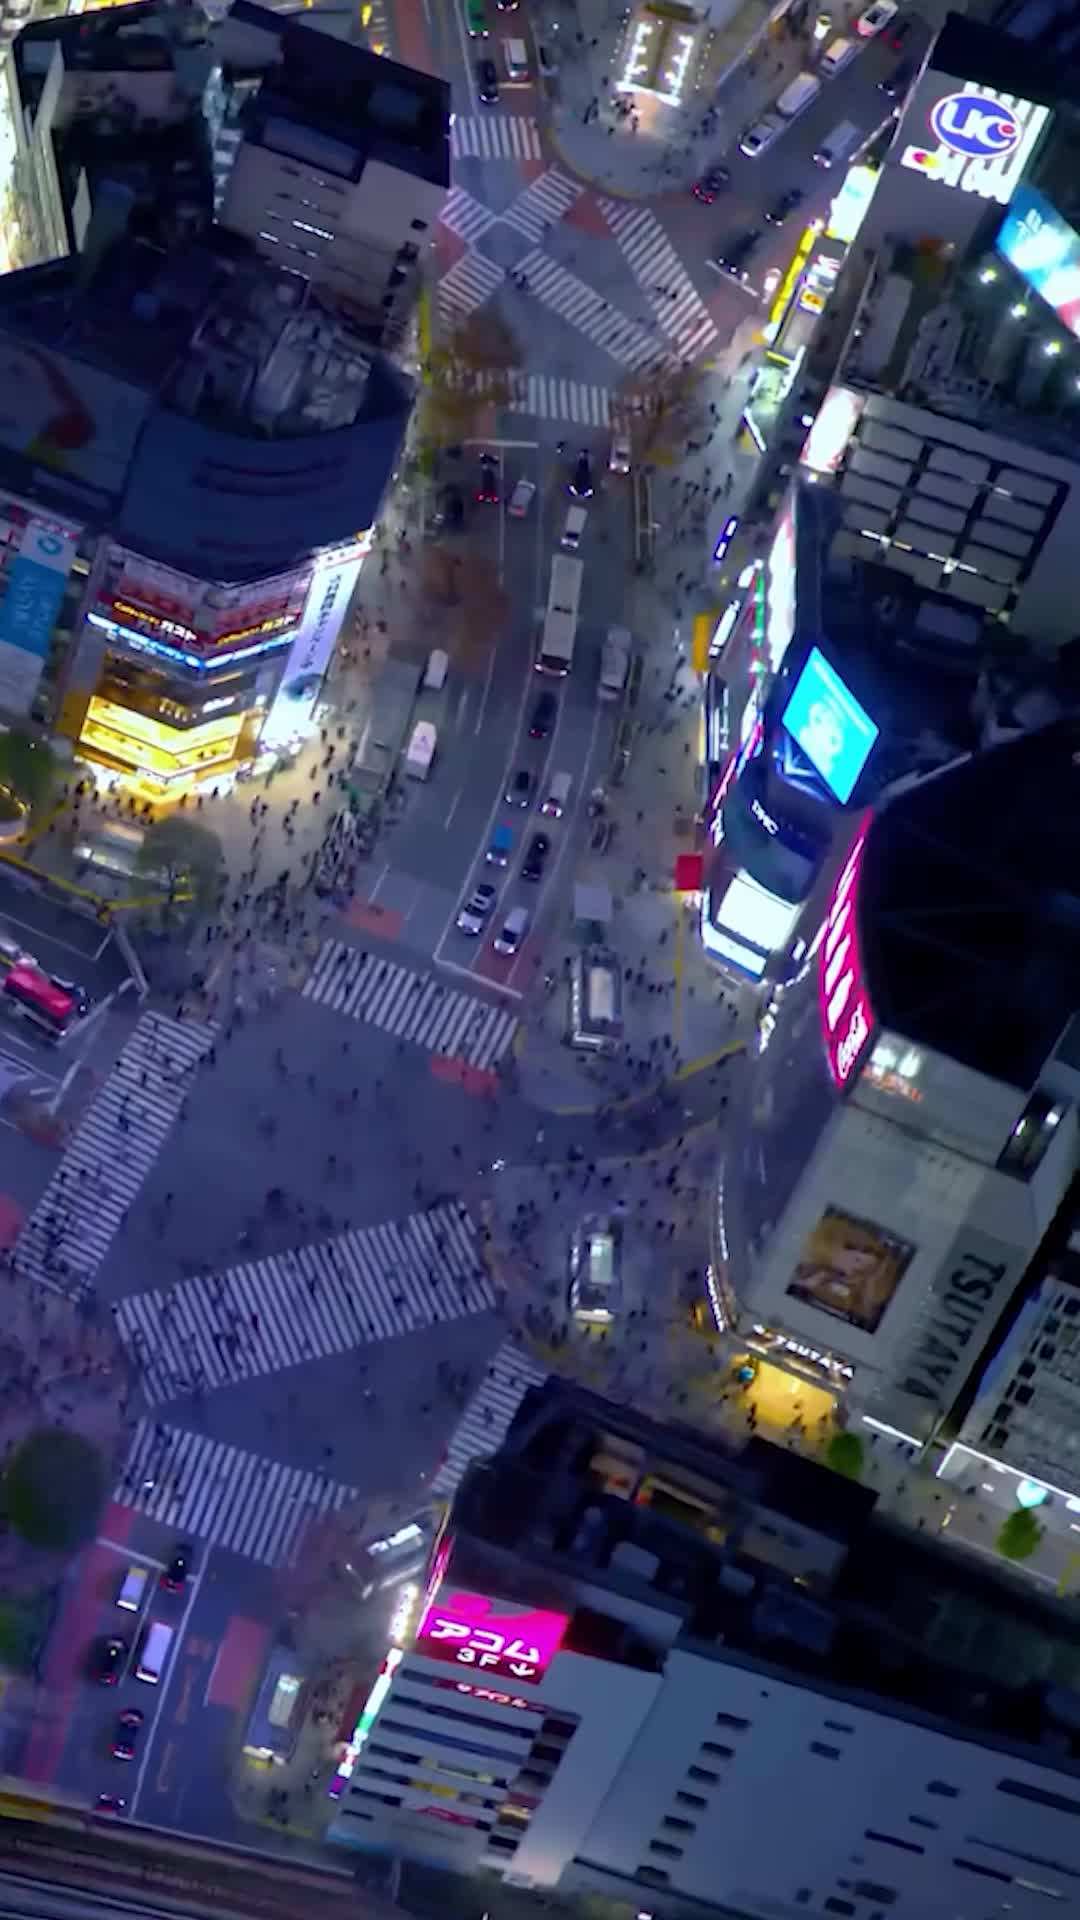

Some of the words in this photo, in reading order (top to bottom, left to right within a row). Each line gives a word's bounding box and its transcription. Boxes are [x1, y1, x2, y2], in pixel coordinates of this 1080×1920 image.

[896, 1252, 1006, 1400] TSUTAYA
[430, 1618, 541, 1664] アコム
[456, 1647, 501, 1667] 3F
